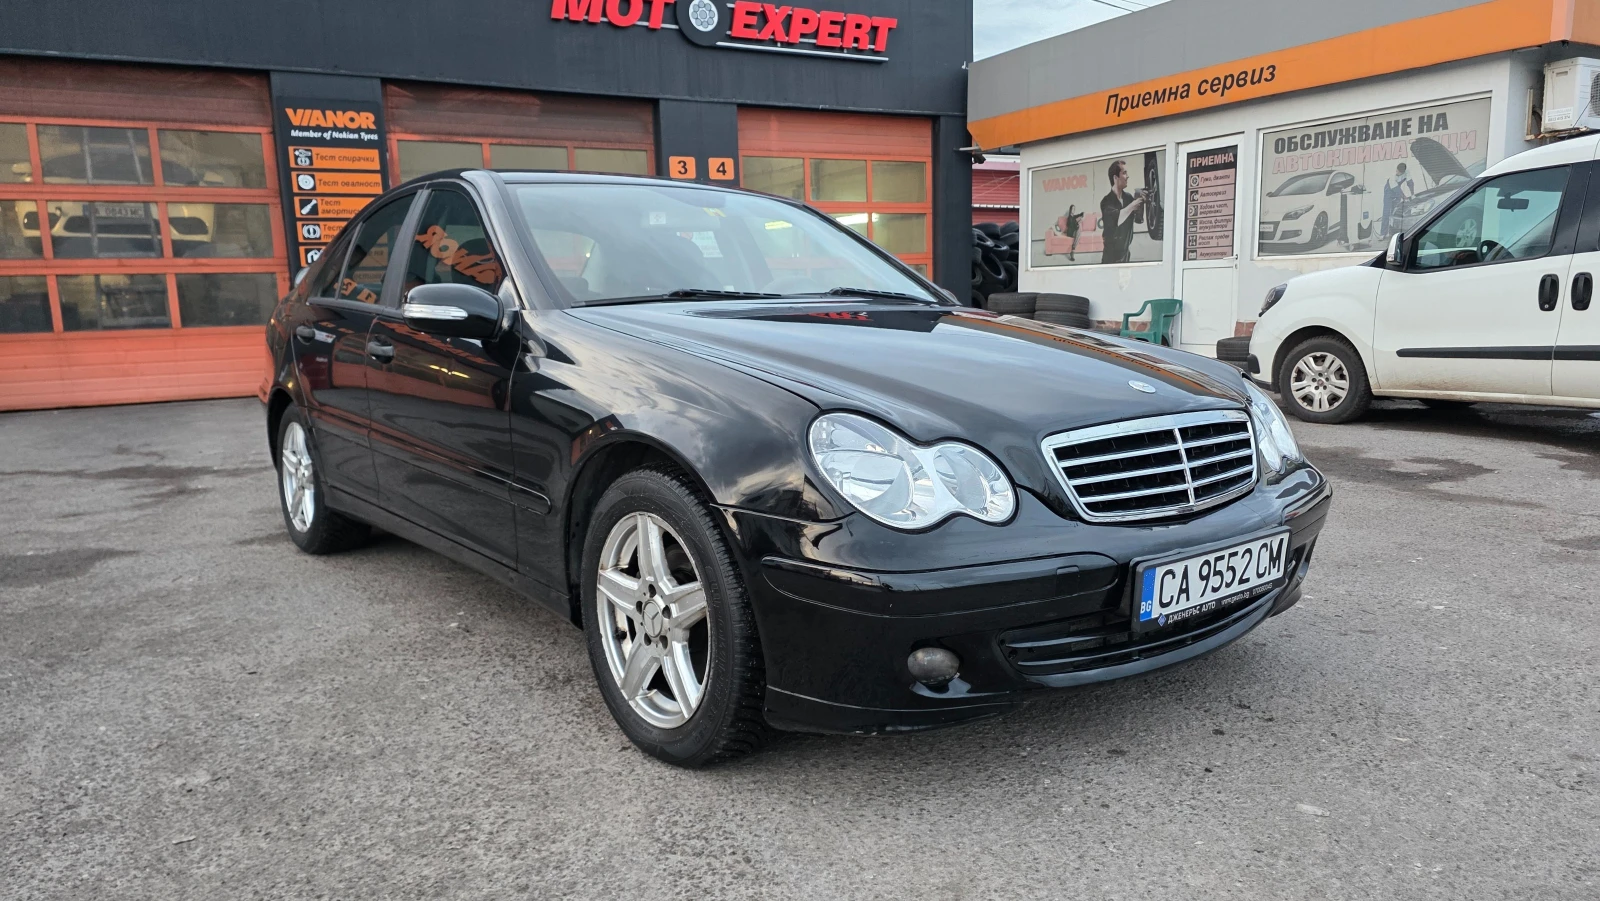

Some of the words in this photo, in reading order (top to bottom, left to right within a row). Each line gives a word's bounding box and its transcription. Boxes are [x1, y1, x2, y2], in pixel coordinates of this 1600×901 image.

[730, 1, 897, 52] EXPERT
[1105, 82, 1191, 117] Приемна
[1197, 64, 1277, 97] сервиз
[285, 108, 377, 129] VIANOR
[290, 129, 322, 138] Member
[322, 130, 332, 140] of
[332, 131, 359, 140] Nokian
[360, 132, 379, 141] Tyres
[1274, 117, 1412, 154] ОБСЛУЖВАНЕ
[1417, 112, 1449, 134] НА
[315, 153, 336, 161] Тест
[337, 155, 375, 164] спирачки
[1190, 152, 1234, 168] ПРИЕМНА
[677, 160, 688, 175] 3
[716, 161, 727, 176] 4
[318, 179, 339, 187] Тест
[1158, 565, 1190, 608] CA
[1199, 547, 1253, 598] 9552
[1256, 537, 1284, 579] CM
[1140, 601, 1152, 614] BG
[1201, 601, 1216, 612] АУТО
